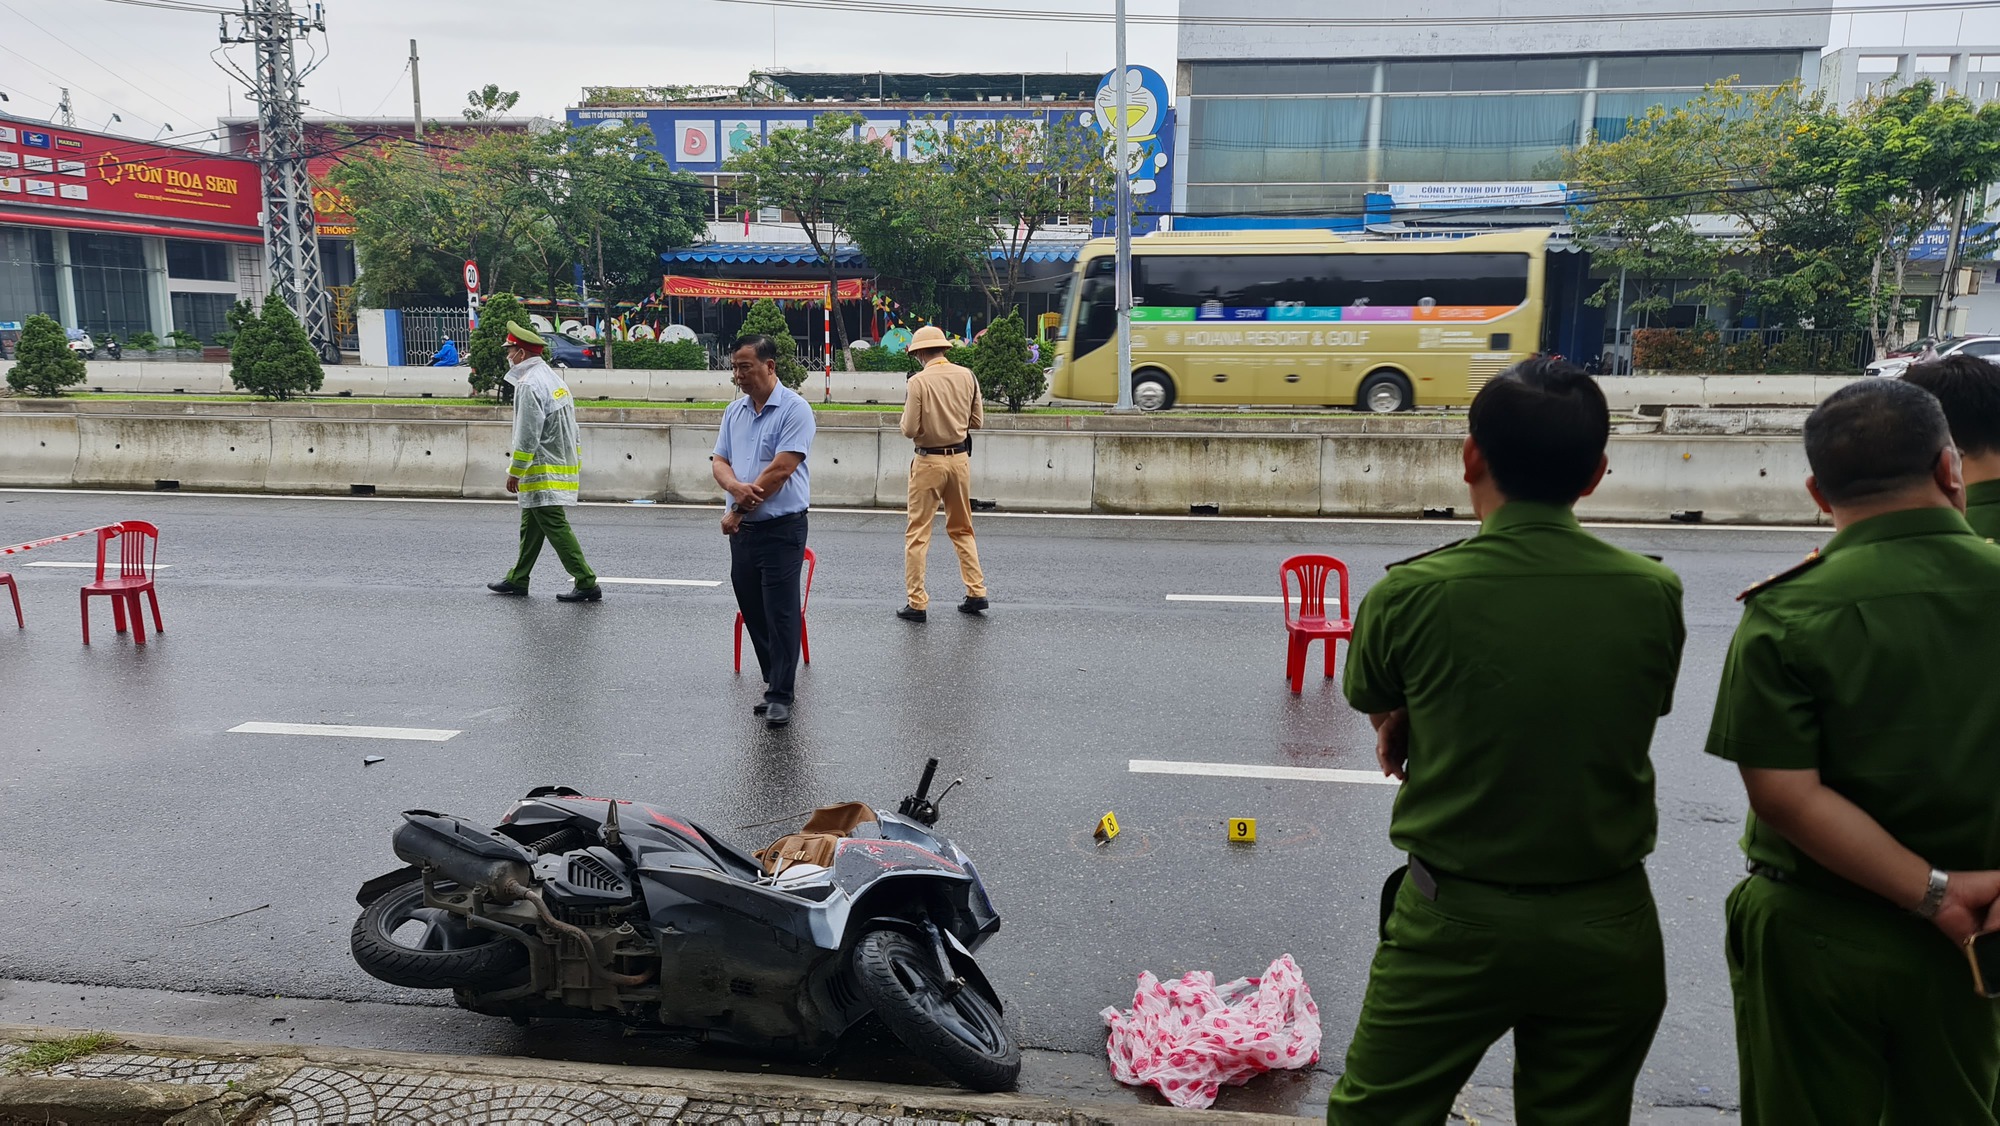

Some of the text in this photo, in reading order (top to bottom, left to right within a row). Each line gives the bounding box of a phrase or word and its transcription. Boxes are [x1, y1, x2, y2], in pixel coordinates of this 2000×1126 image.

[125, 159, 163, 184] TÔN
[165, 169, 203, 190] HOA
[205, 175, 238, 195] SEN
[1421, 185, 1445, 194] CÔNG
[1448, 186, 1457, 194] TY
[1460, 186, 1482, 194] TNHH
[1485, 186, 1502, 194] DUY
[1161, 309, 1190, 318] PLAY
[1235, 309, 1264, 318] STAY
[1309, 309, 1337, 318] DINE
[1438, 308, 1487, 318] EXPLORE
[1246, 331, 1310, 346] RESORT
[1311, 331, 1324, 346] &
[1325, 331, 1370, 346] GOLF
[1107, 817, 1114, 832] 8
[1237, 821, 1248, 837] 9
